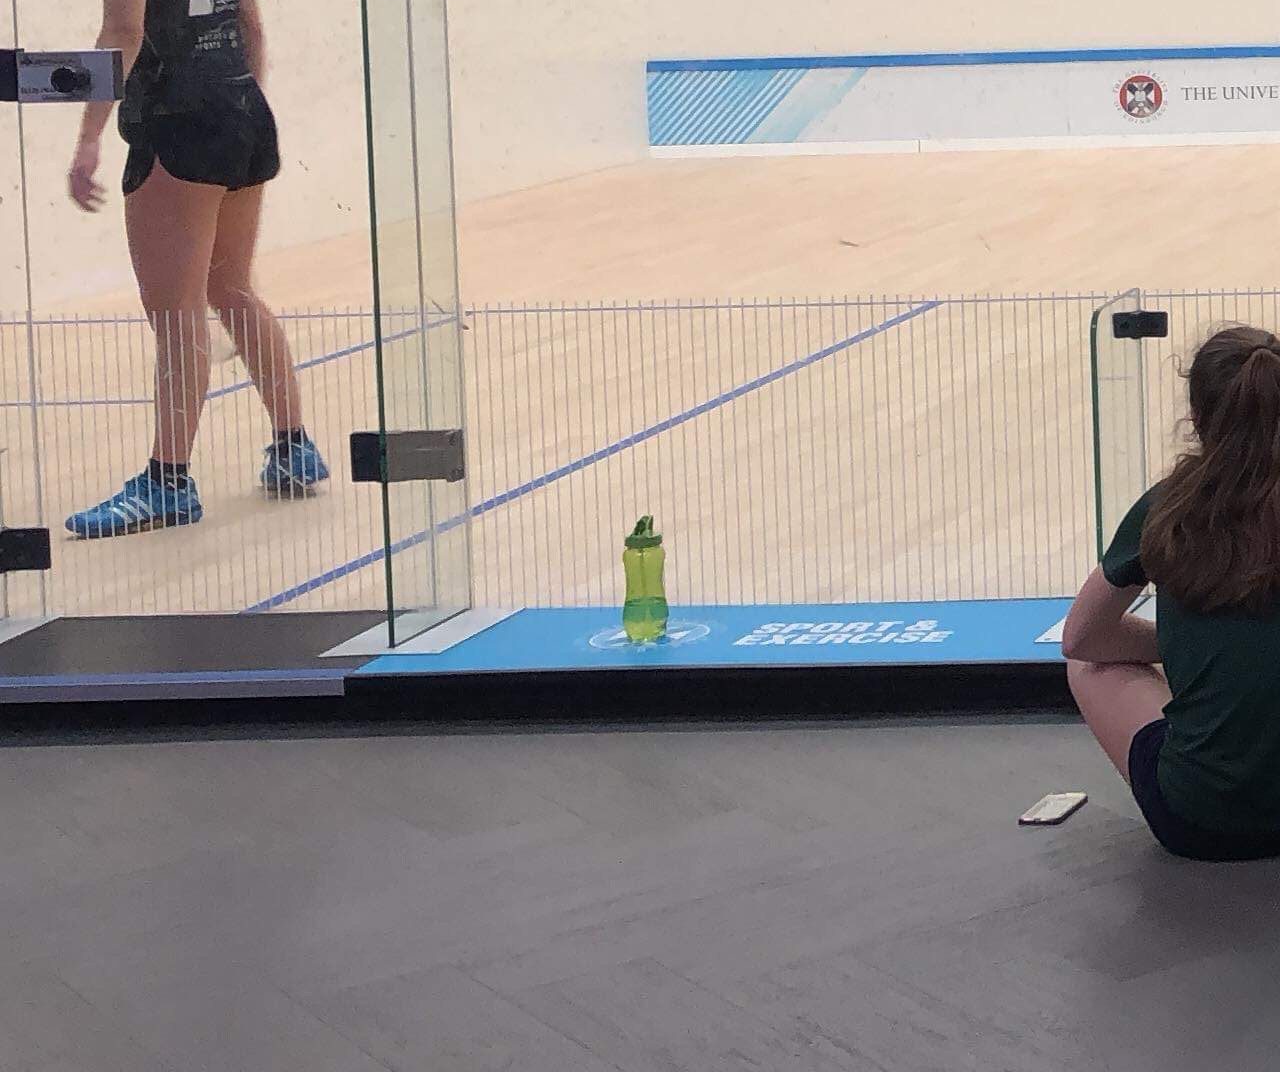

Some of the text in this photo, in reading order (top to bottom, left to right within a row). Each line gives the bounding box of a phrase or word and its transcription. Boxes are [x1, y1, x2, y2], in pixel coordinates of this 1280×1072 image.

[1180, 85, 1217, 101] THE
[752, 620, 904, 634] SPORT
[732, 630, 955, 647] EXERCISE
